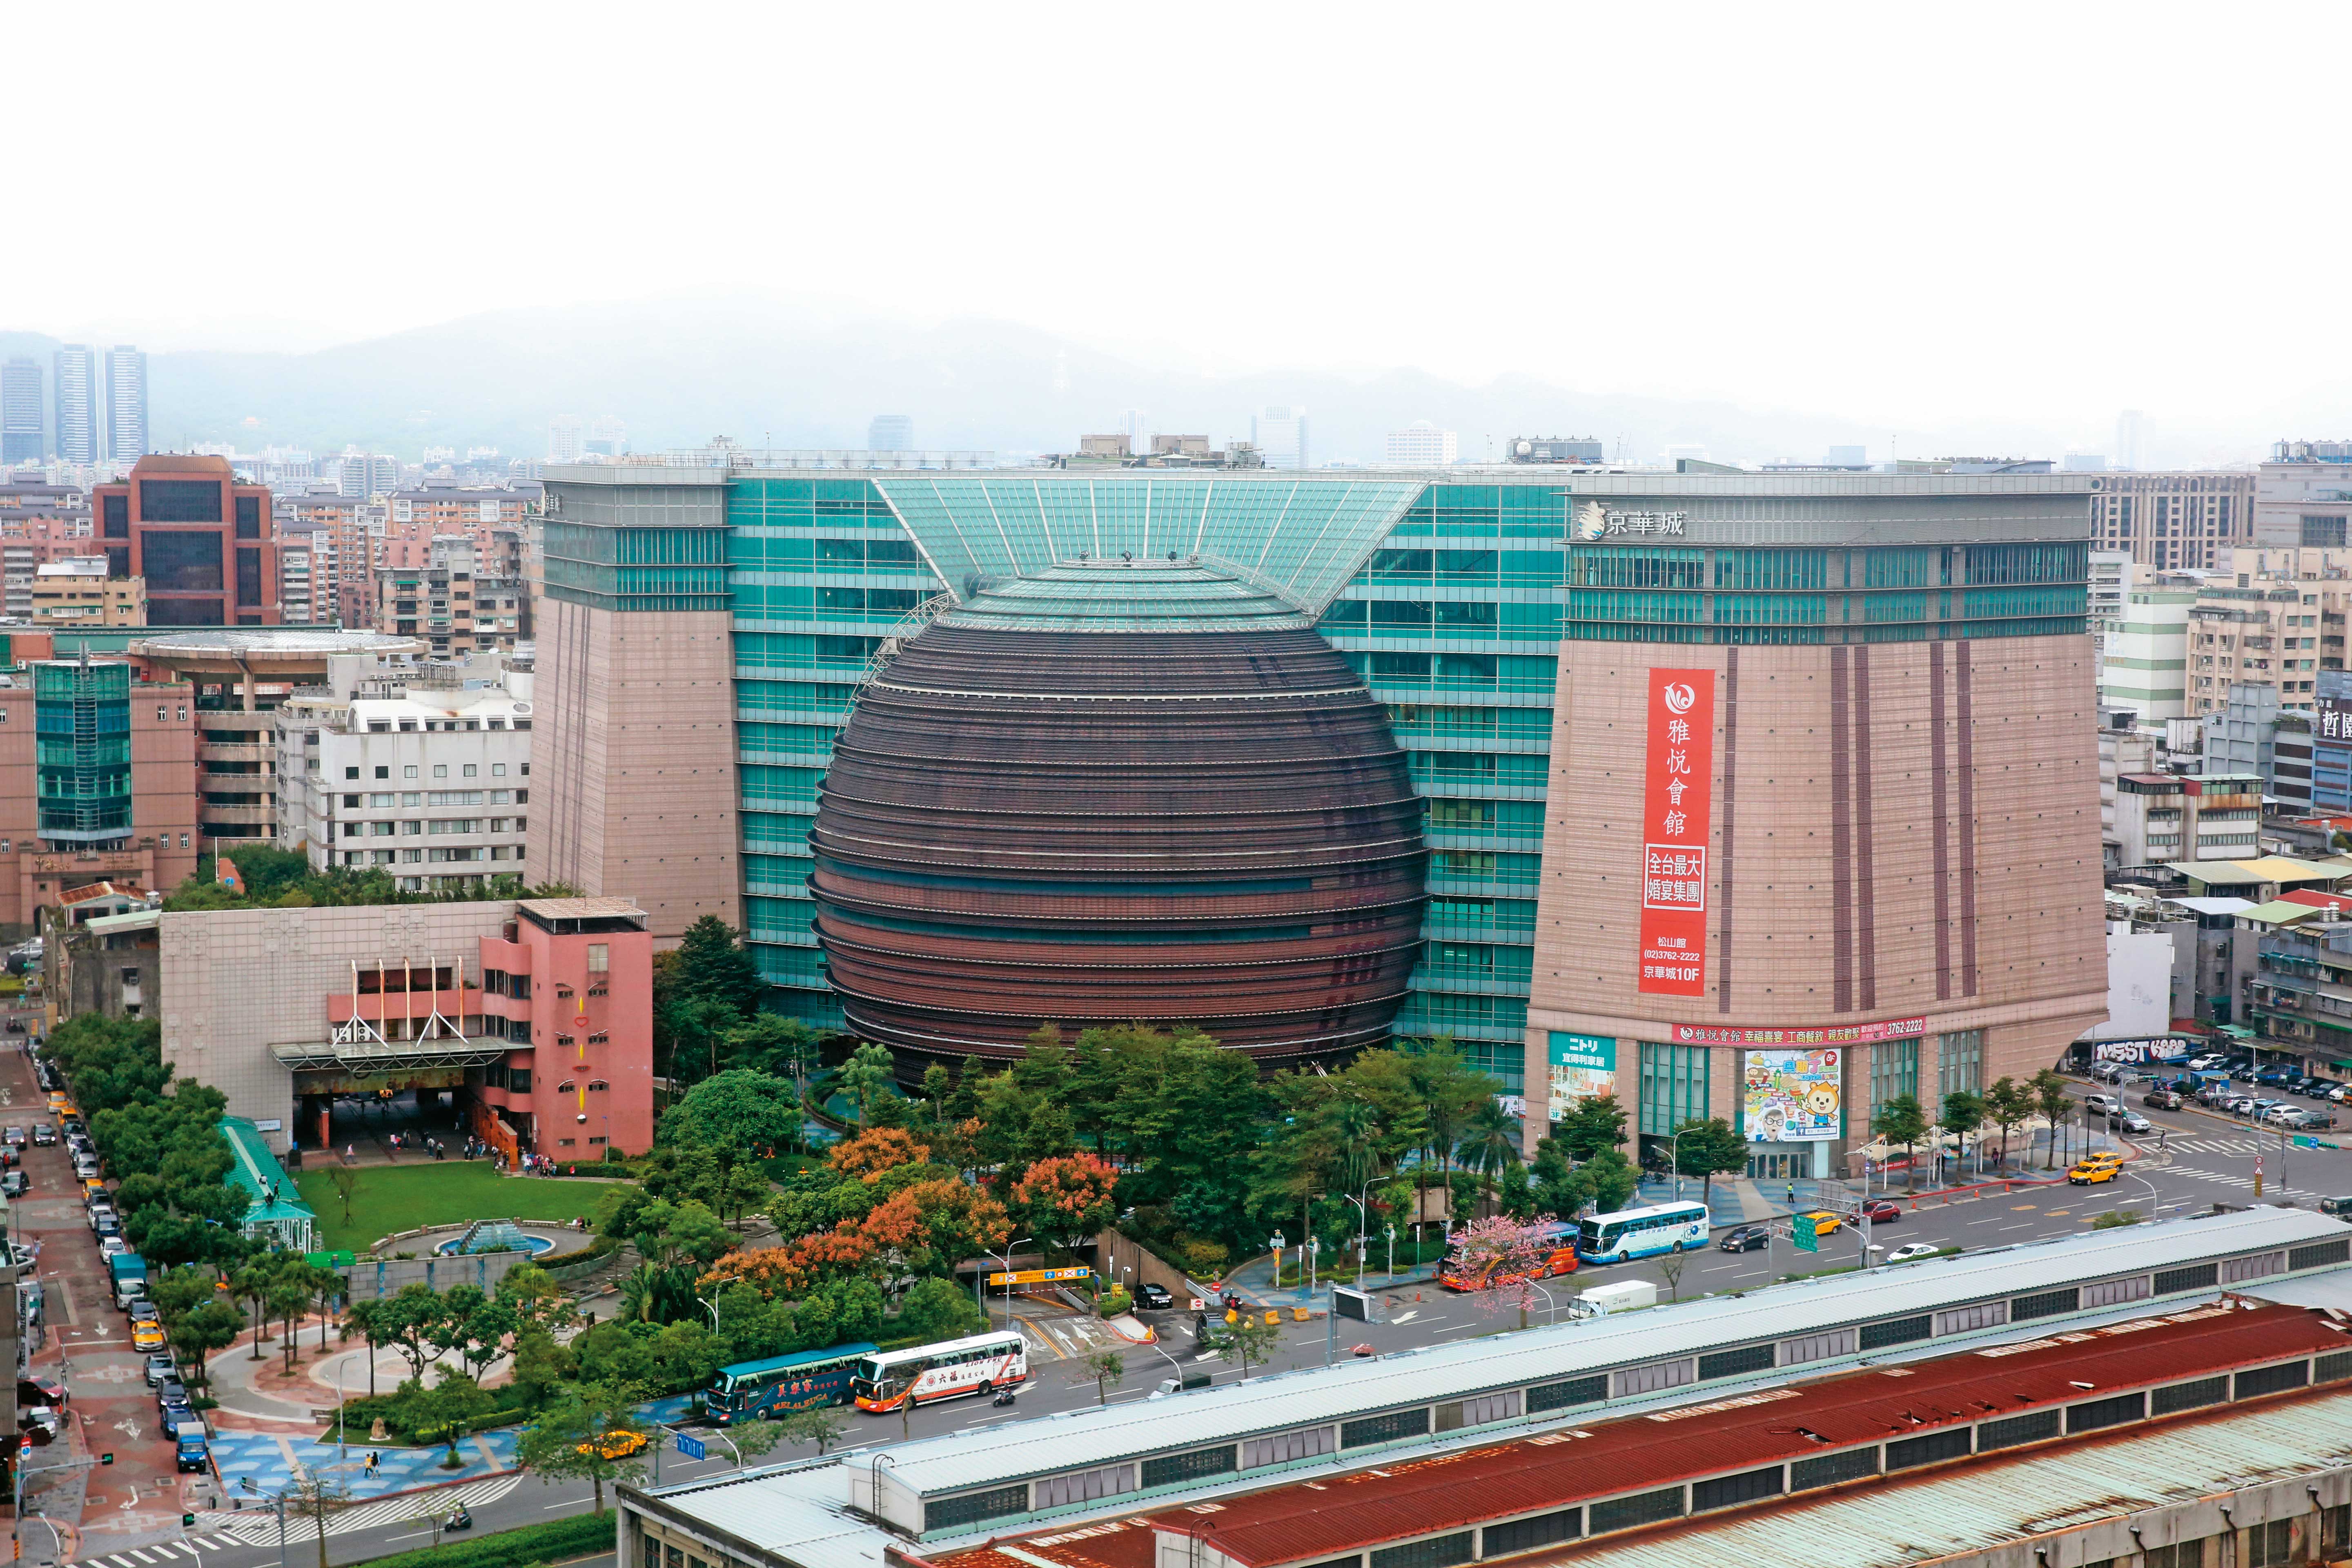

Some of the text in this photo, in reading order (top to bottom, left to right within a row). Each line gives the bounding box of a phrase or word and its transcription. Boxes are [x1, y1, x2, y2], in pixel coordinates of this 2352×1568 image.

[1606, 510, 1683, 535] 京華城
[1649, 853, 1701, 876] 全台最大
[1648, 878, 1699, 902] 婚宴集團
[1657, 936, 1686, 948] 松山館
[1644, 949, 1699, 961] (02)3762-2222
[1644, 965, 1699, 981] 京華城10F
[1887, 1019, 1923, 1036] 3762-2222
[1569, 1038, 1598, 1053] ニトリ
[1562, 1053, 1604, 1067] 宜得利家居
[1826, 1054, 1835, 1062] 8F
[1782, 1059, 1821, 1074] 奧斯丁
[965, 1359, 984, 1368] LIOW
